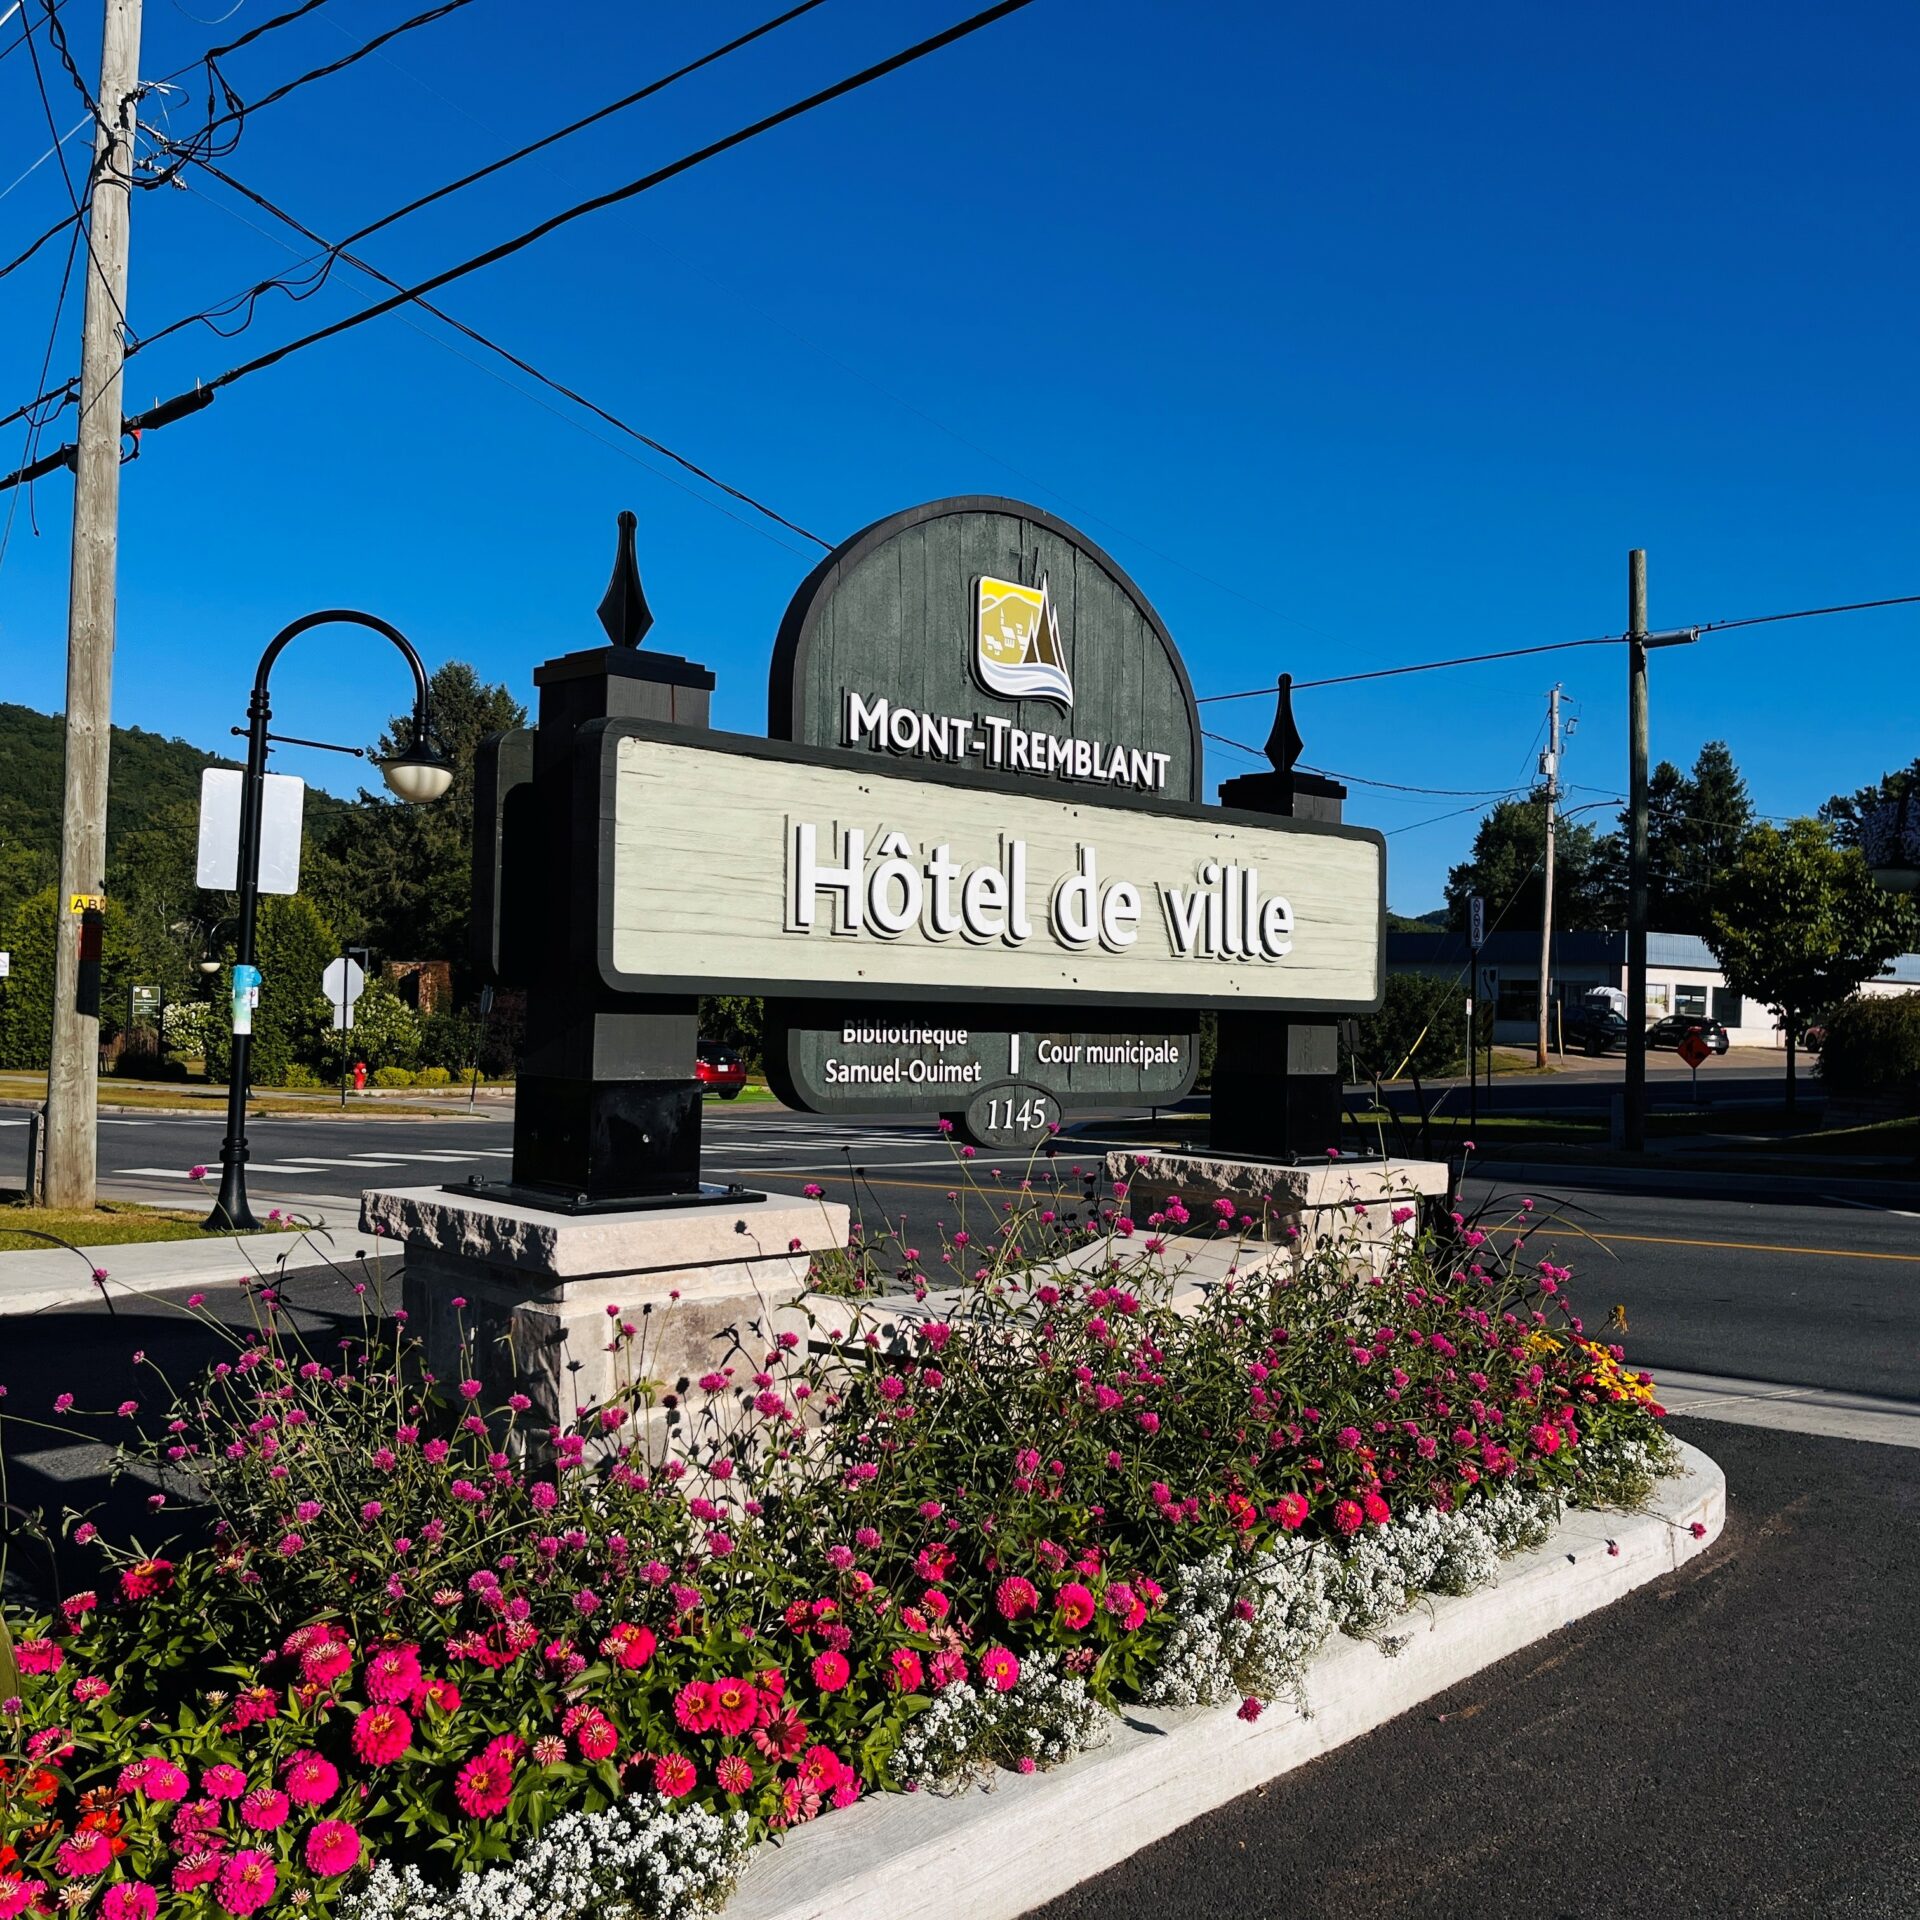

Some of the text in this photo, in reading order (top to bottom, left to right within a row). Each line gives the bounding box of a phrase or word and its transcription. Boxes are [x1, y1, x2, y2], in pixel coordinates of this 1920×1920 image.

[798, 823, 1294, 955] Hôtel de ville
[843, 1019, 968, 1052] Bibliothèque
[825, 1057, 982, 1083] Samuel-Ouimet
[1037, 1039, 1179, 1070] Cour municipale
[987, 1098, 1047, 1132] 1145
